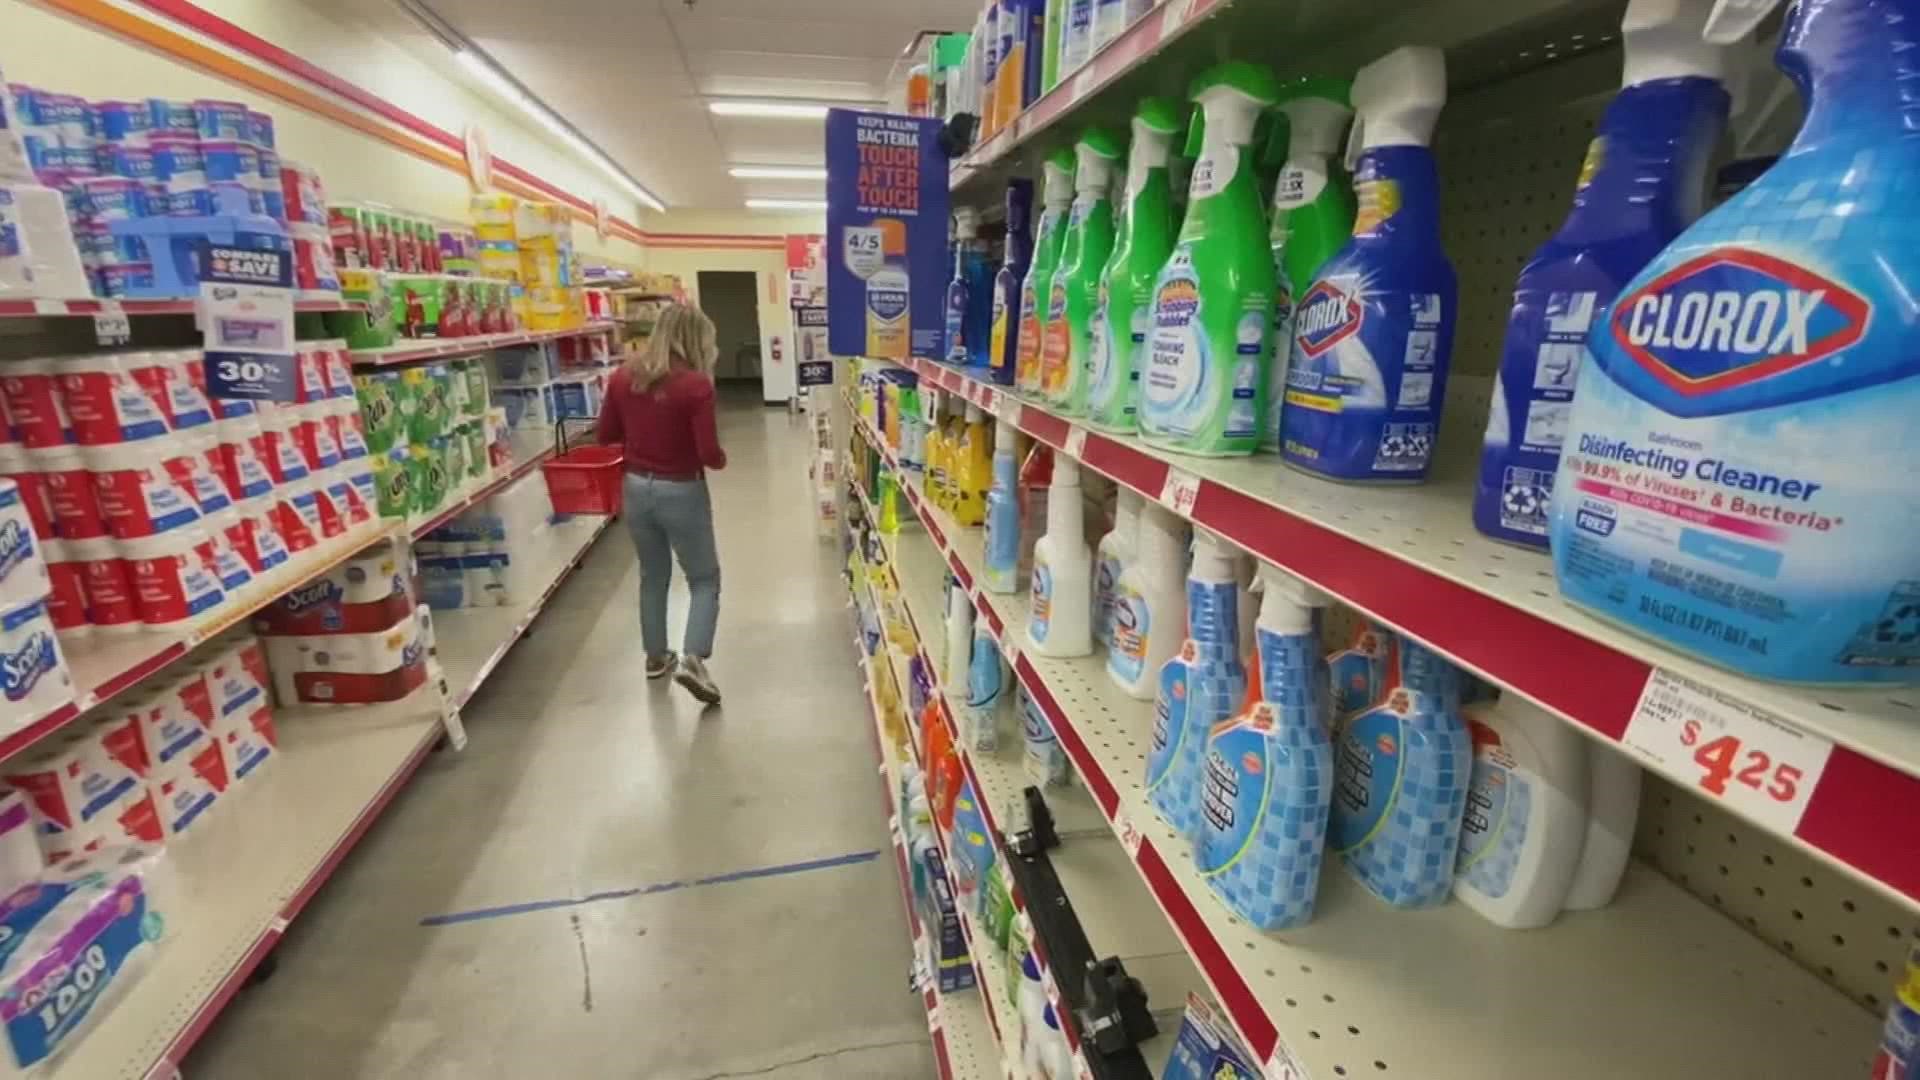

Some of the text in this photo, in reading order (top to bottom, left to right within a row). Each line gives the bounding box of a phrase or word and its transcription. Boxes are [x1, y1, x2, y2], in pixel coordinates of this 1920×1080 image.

[857, 116, 919, 131] KEEPS KILLING
[857, 128, 919, 146] BACTERIA
[857, 144, 919, 168] TOUCH
[857, 165, 919, 188] AFTER
[857, 186, 919, 209] TOUCH
[848, 232, 880, 250] 4/5
[210, 248, 280, 264] COMPARE
[228, 259, 280, 278] SAVE
[1627, 288, 1828, 357] CLOROX
[1648, 432, 1703, 451] Bathroom
[1578, 433, 1822, 502] Disinfecting Cleaner
[1583, 461, 1623, 482] 99.9%
[1625, 471, 1641, 488] of
[1710, 491, 1723, 508] &
[1579, 512, 1612, 533] FREE
[287, 580, 329, 611] Scott
[3, 630, 46, 690] Scott
[39, 944, 106, 1031] 1000
